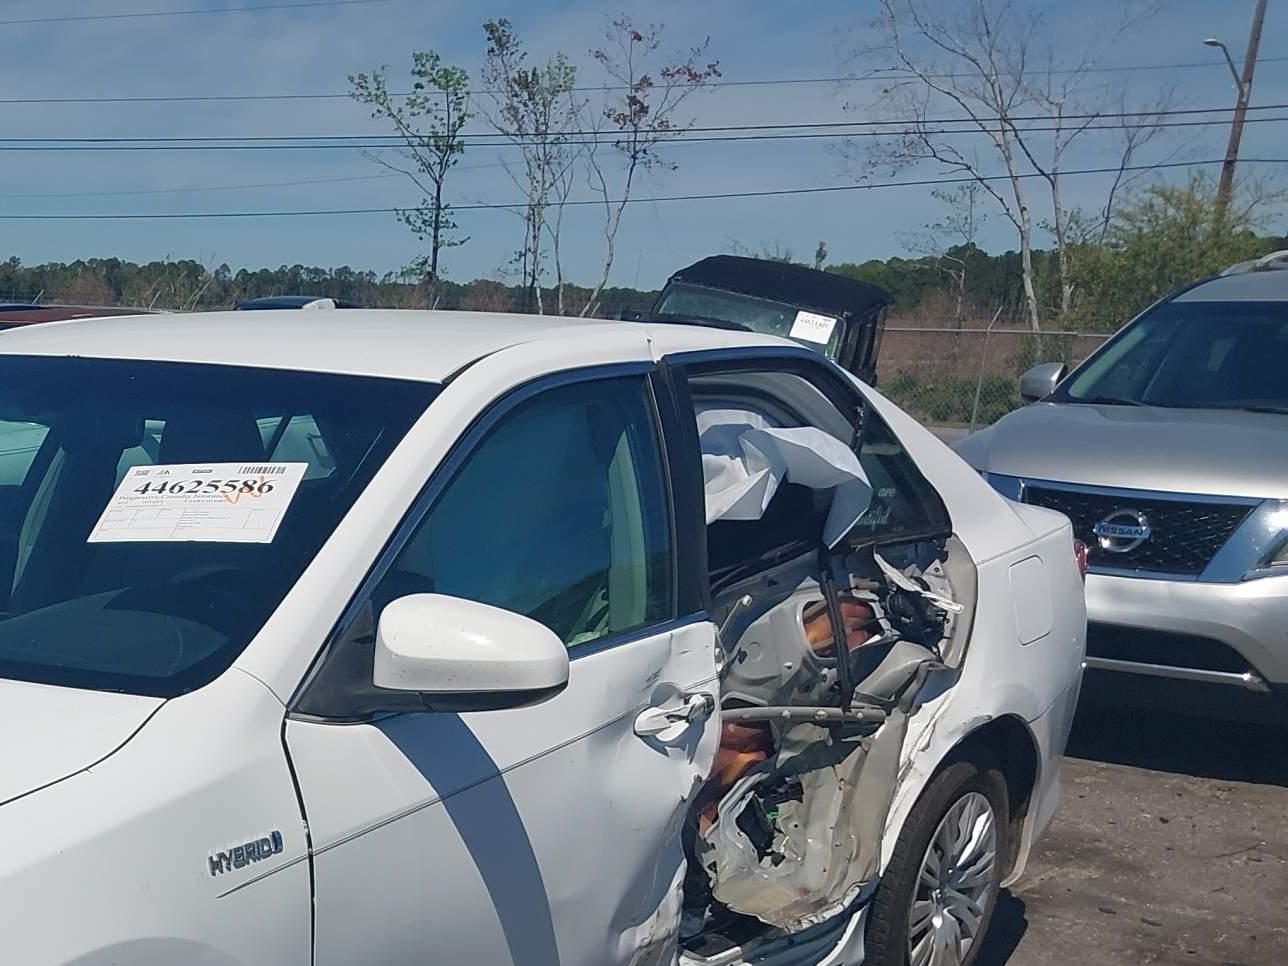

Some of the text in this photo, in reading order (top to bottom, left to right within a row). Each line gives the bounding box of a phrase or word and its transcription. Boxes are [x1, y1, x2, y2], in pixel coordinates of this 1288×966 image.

[134, 479, 277, 495] 44625586
[878, 488, 896, 498] are
[1098, 526, 1144, 536] NISSAN
[208, 837, 272, 876] HYBRID
